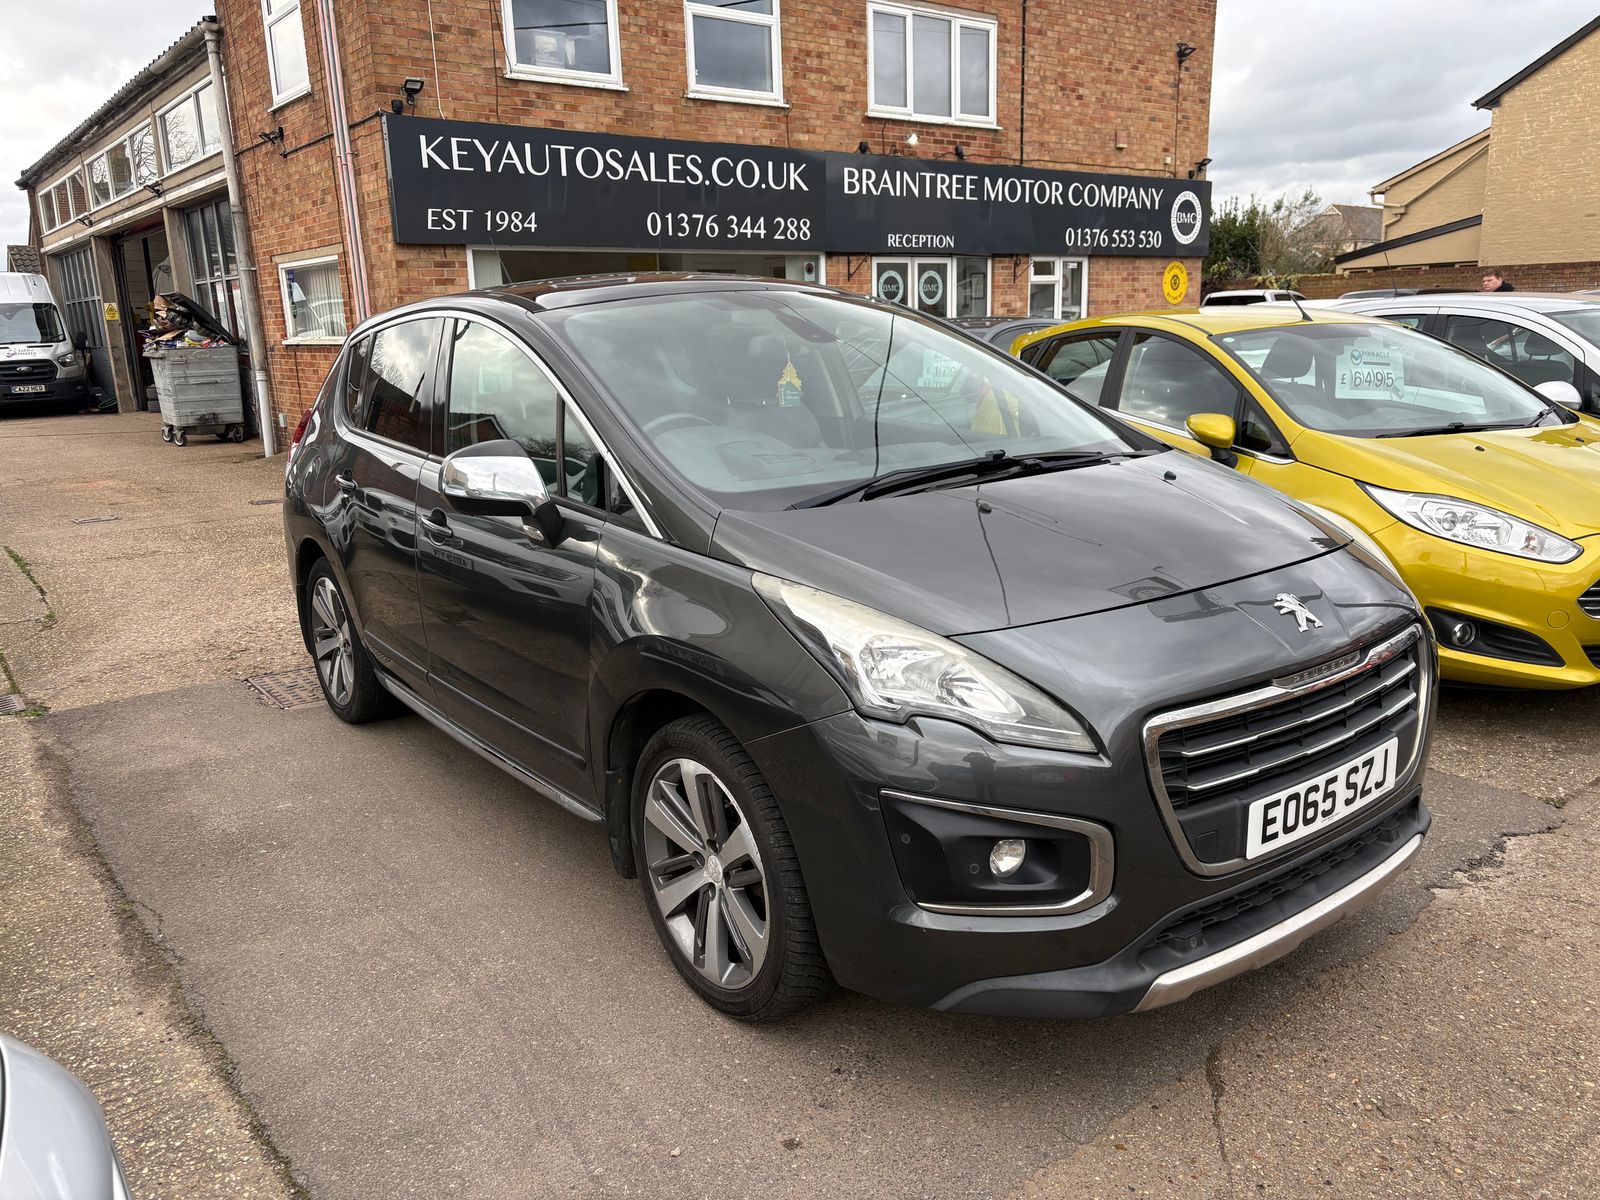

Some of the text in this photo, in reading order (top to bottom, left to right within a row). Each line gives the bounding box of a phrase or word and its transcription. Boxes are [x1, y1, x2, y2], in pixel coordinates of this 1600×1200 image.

[419, 134, 809, 191] KEYAUTOSALES.CO.UK
[843, 167, 979, 201] BRAINTREE
[984, 176, 1064, 206] MOTOR
[1068, 182, 1164, 210] COMPANY
[427, 208, 537, 233] EST 1984
[646, 212, 811, 241] 01376 344 288
[1176, 211, 1197, 224] BMC
[887, 233, 955, 248] RECEPTION
[1065, 227, 1109, 247] 01376
[1111, 229, 1135, 248] 553
[1138, 230, 1162, 249] 530
[882, 284, 899, 292] BMC
[923, 284, 939, 292] BMC
[1361, 350, 1391, 359] PINNACLE
[1261, 748, 1389, 845] EO65 SZJ
